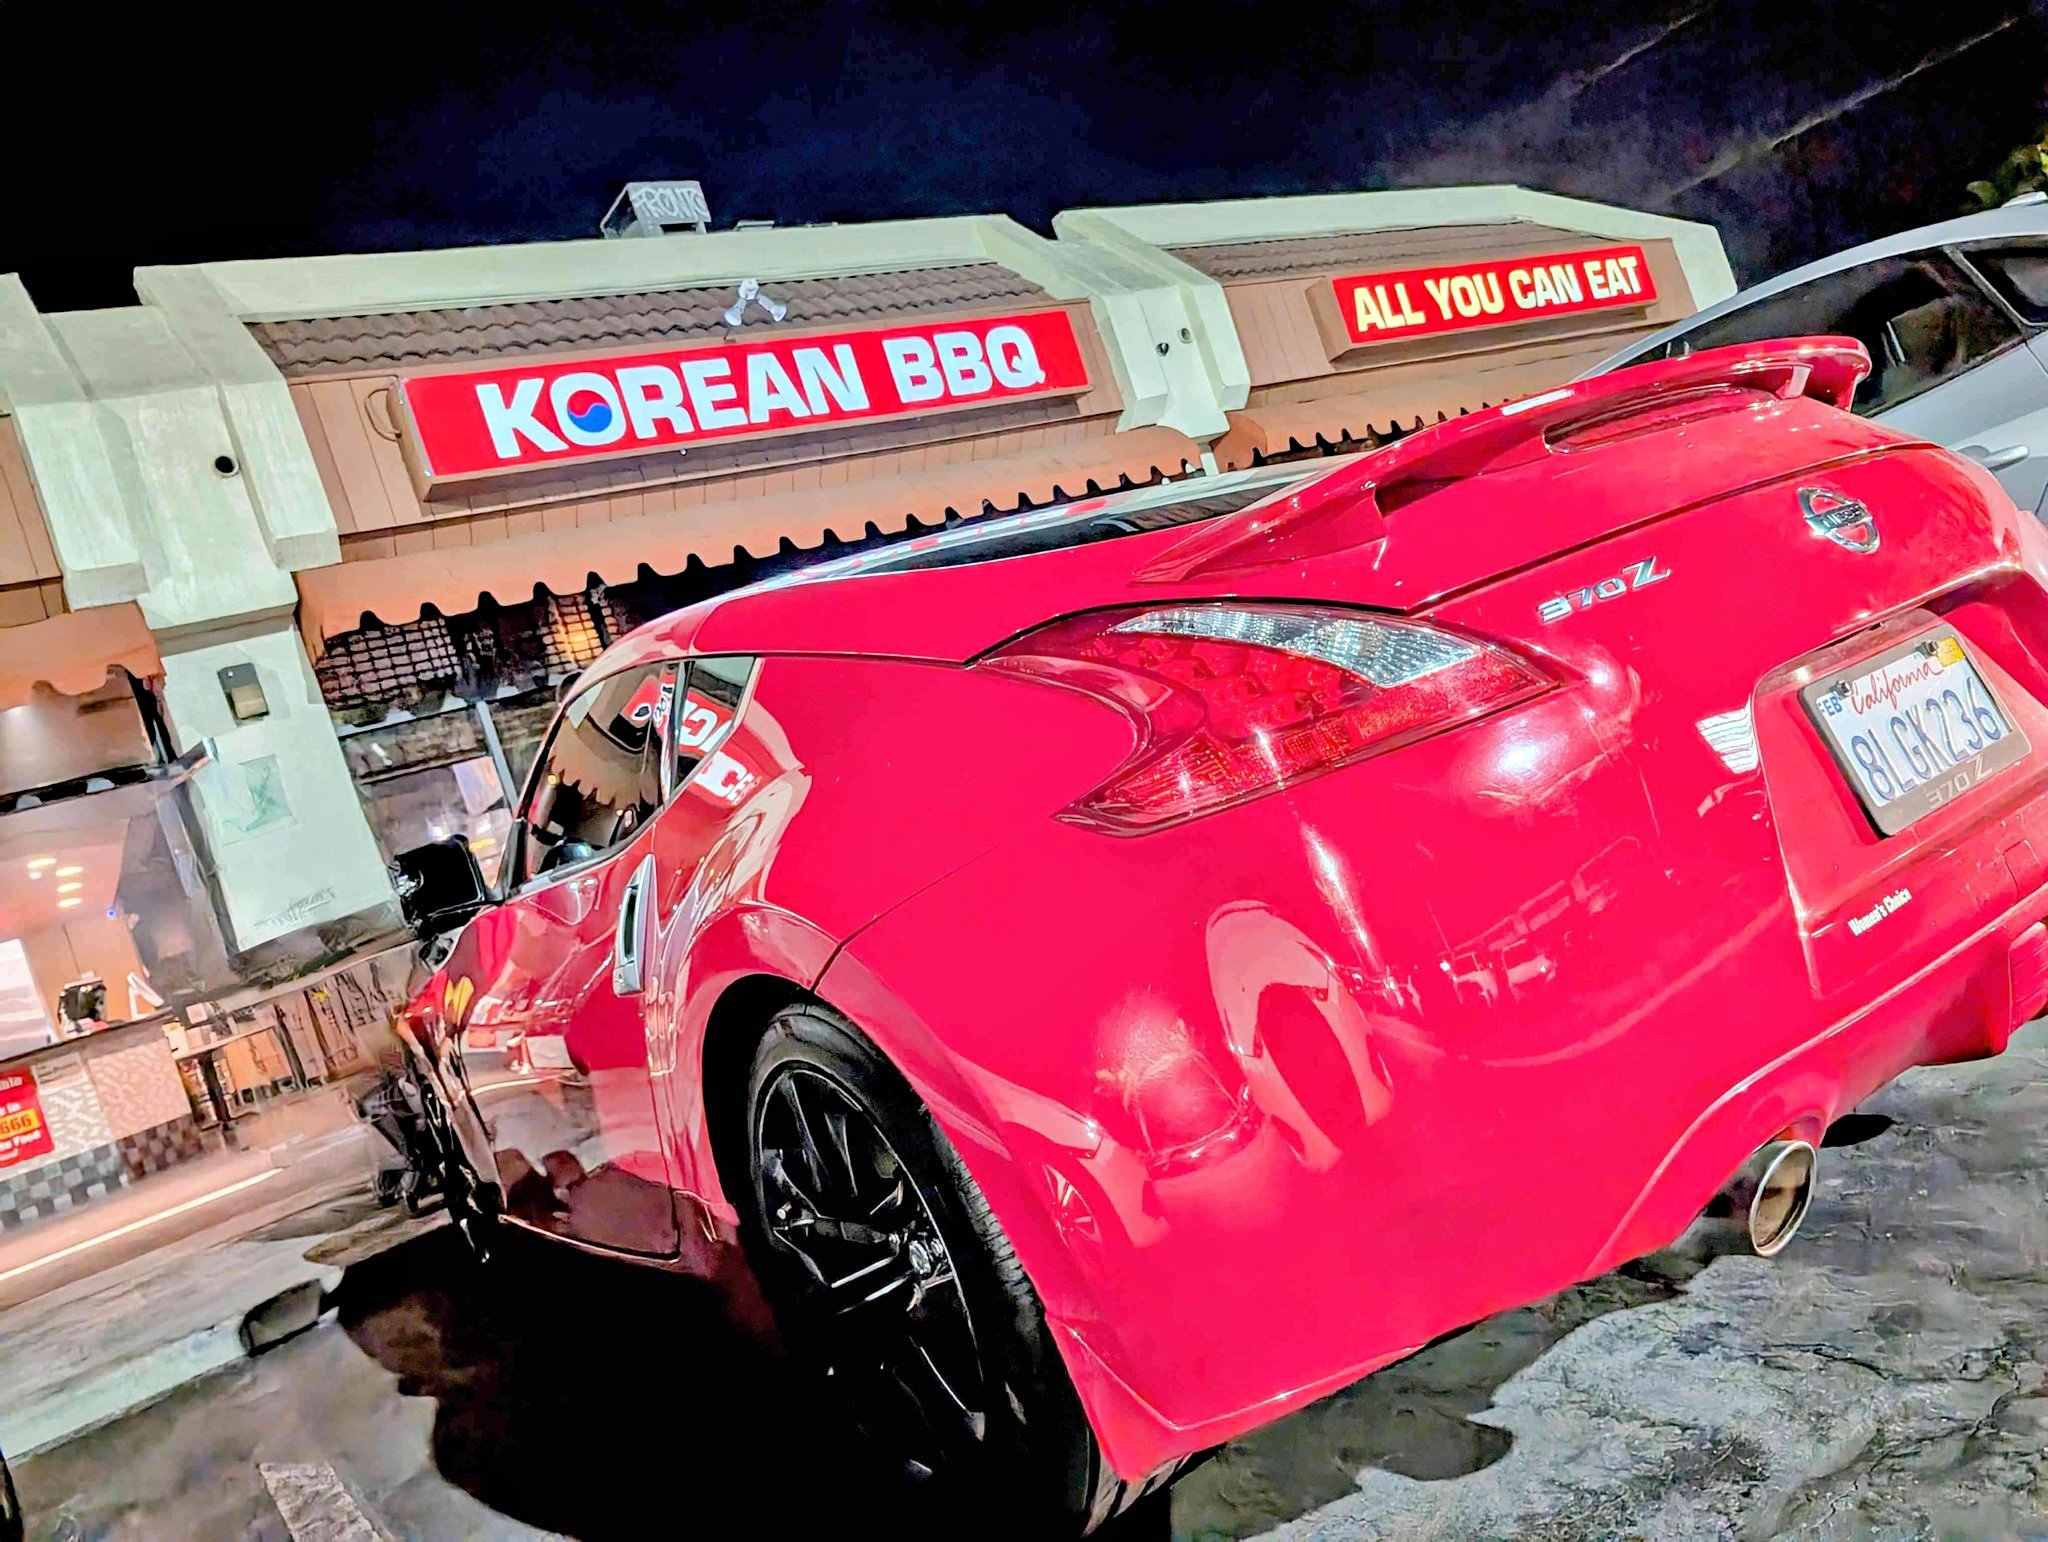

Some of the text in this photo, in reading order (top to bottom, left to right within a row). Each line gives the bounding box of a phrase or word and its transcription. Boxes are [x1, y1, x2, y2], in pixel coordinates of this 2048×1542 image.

[1353, 255, 1642, 333] ALL YOU CAN EAT
[475, 324, 1046, 459] KOREAN BBQ
[1536, 556, 1671, 623] 370Z
[1851, 663, 1944, 715] California
[1851, 677, 2001, 801] 8LGK236
[1848, 888, 1912, 936] Women's Choice
